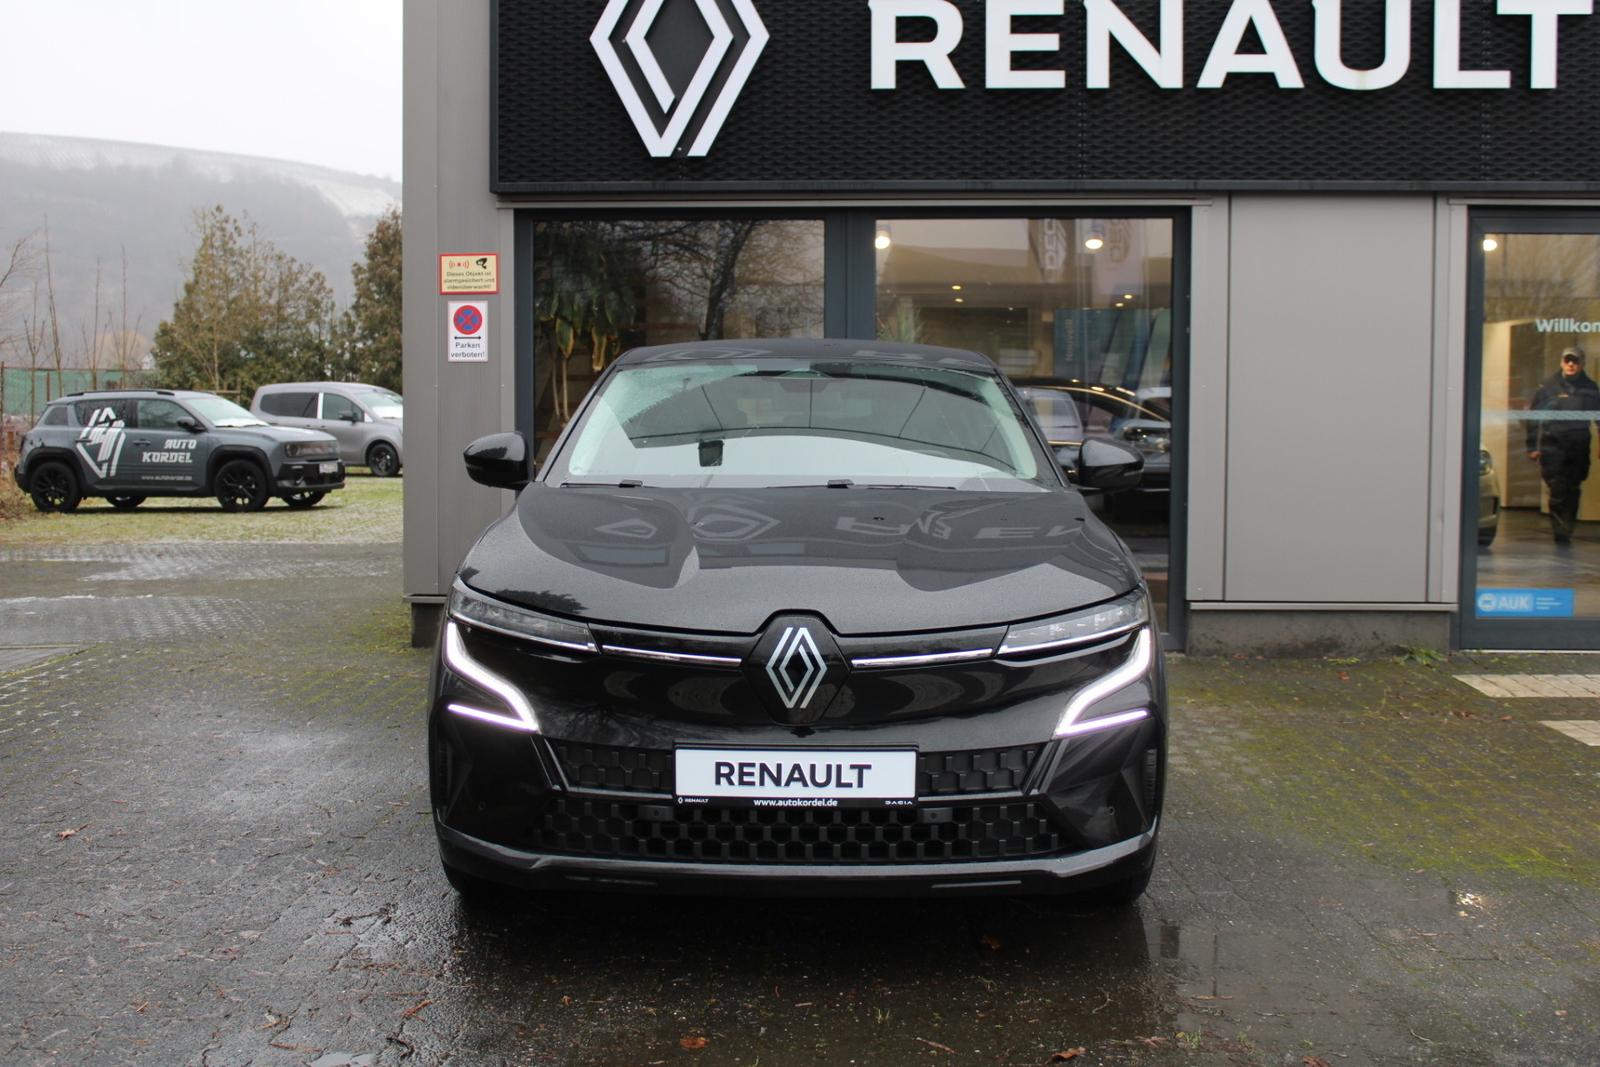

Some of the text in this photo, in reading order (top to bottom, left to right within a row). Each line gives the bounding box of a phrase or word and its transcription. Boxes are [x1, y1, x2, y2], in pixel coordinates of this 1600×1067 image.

[867, 0, 1593, 90] RENAULT
[455, 341, 481, 349] Parken
[163, 439, 198, 450] AUTO
[141, 451, 193, 464] KORDEL
[714, 761, 872, 788] RENAULT
[753, 798, 839, 808] www.autokordel.de
